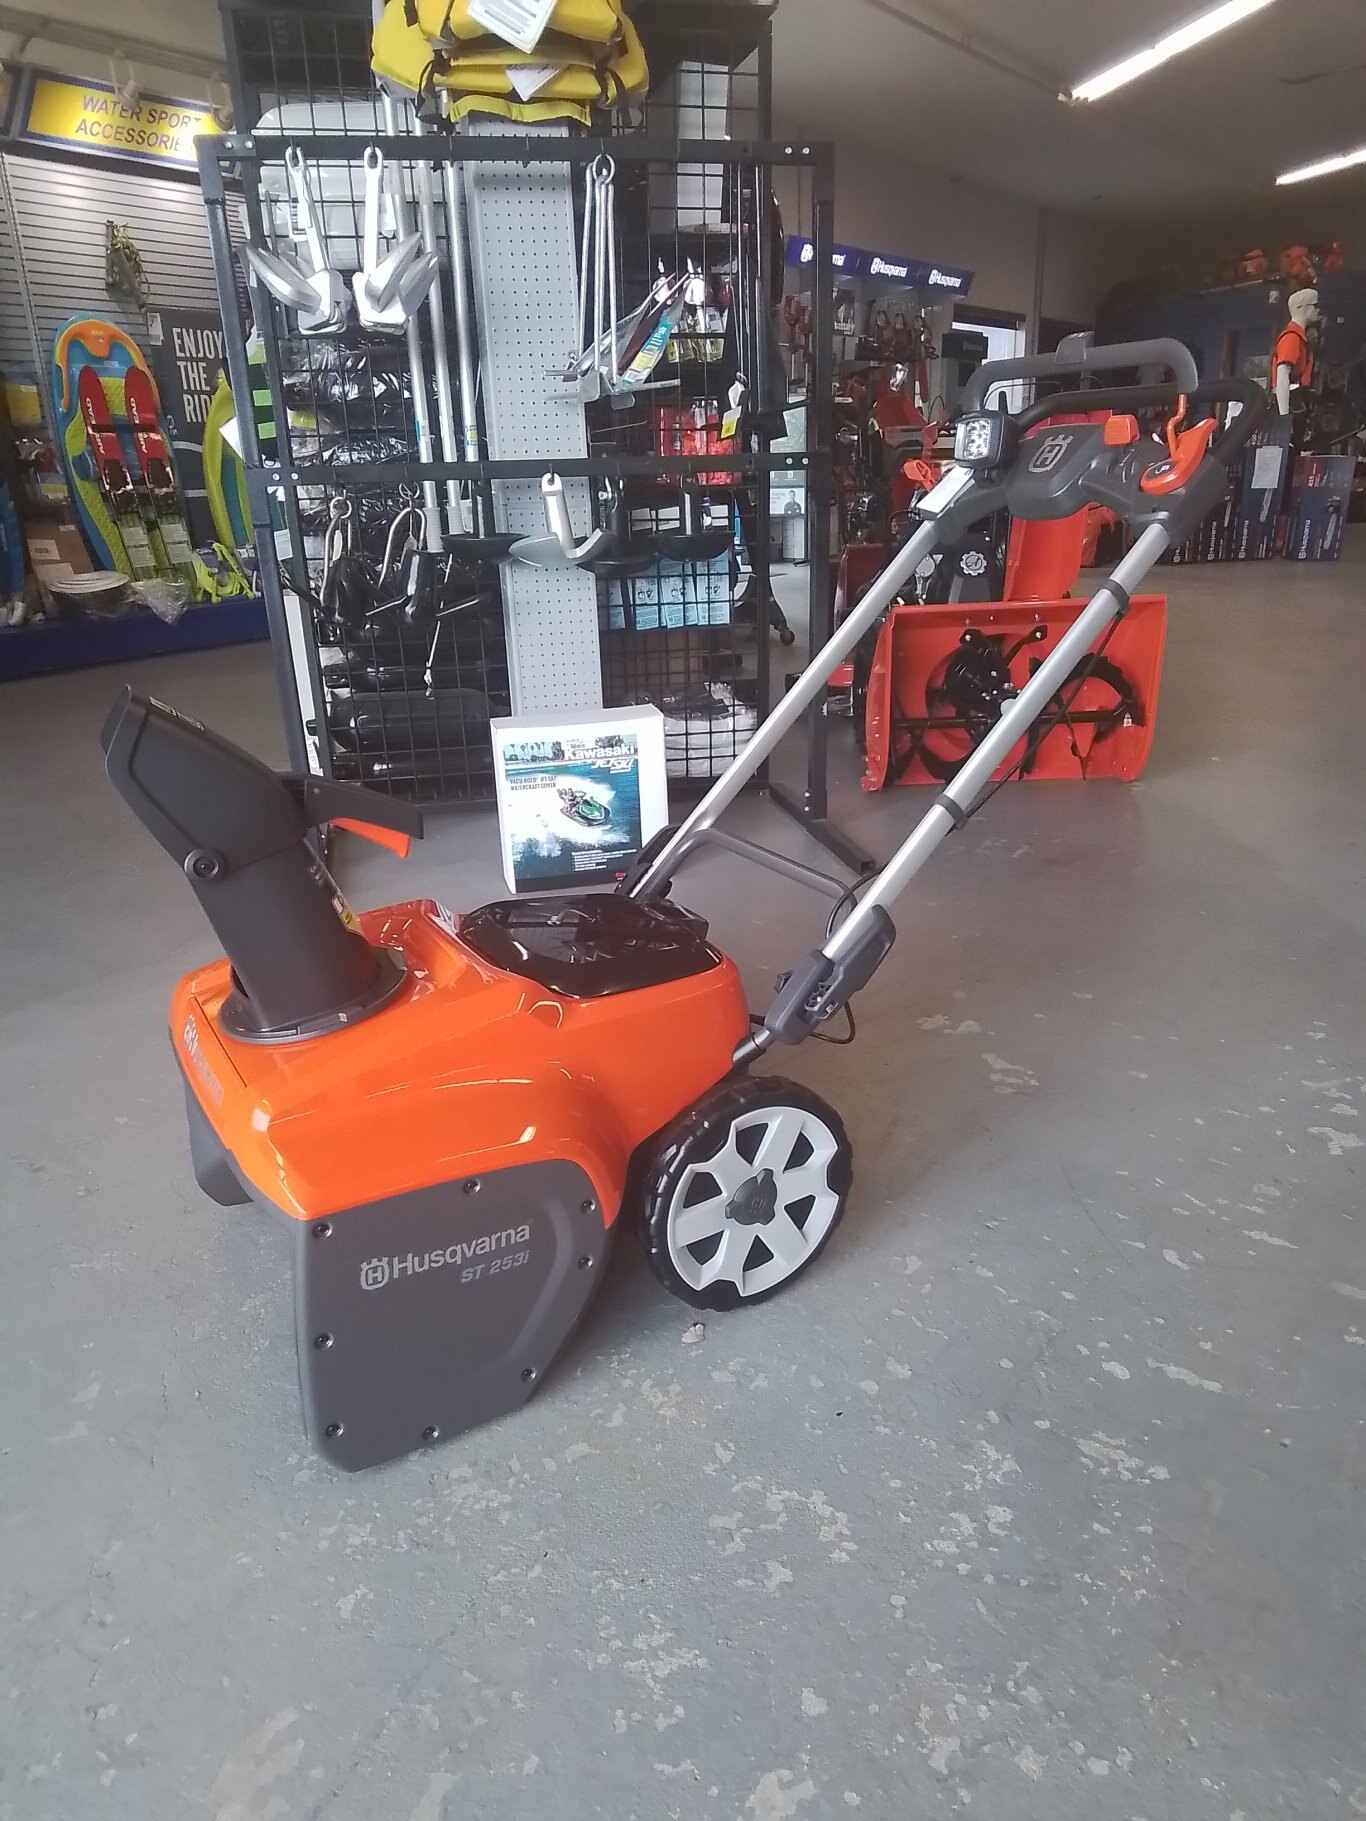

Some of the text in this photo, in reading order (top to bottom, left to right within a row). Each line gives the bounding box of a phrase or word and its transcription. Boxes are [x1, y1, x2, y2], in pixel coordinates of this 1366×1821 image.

[82, 95, 141, 122] WATER
[75, 117, 192, 151] ACCESSORIE
[172, 327, 223, 360] ENJOY
[176, 361, 211, 391] THE
[182, 393, 214, 423] RID
[1300, 519, 1311, 552] Husqvarna
[563, 743, 636, 760] Kawasaki
[393, 1224, 530, 1279] Husqvarna
[461, 1250, 530, 1283] ST 253i
